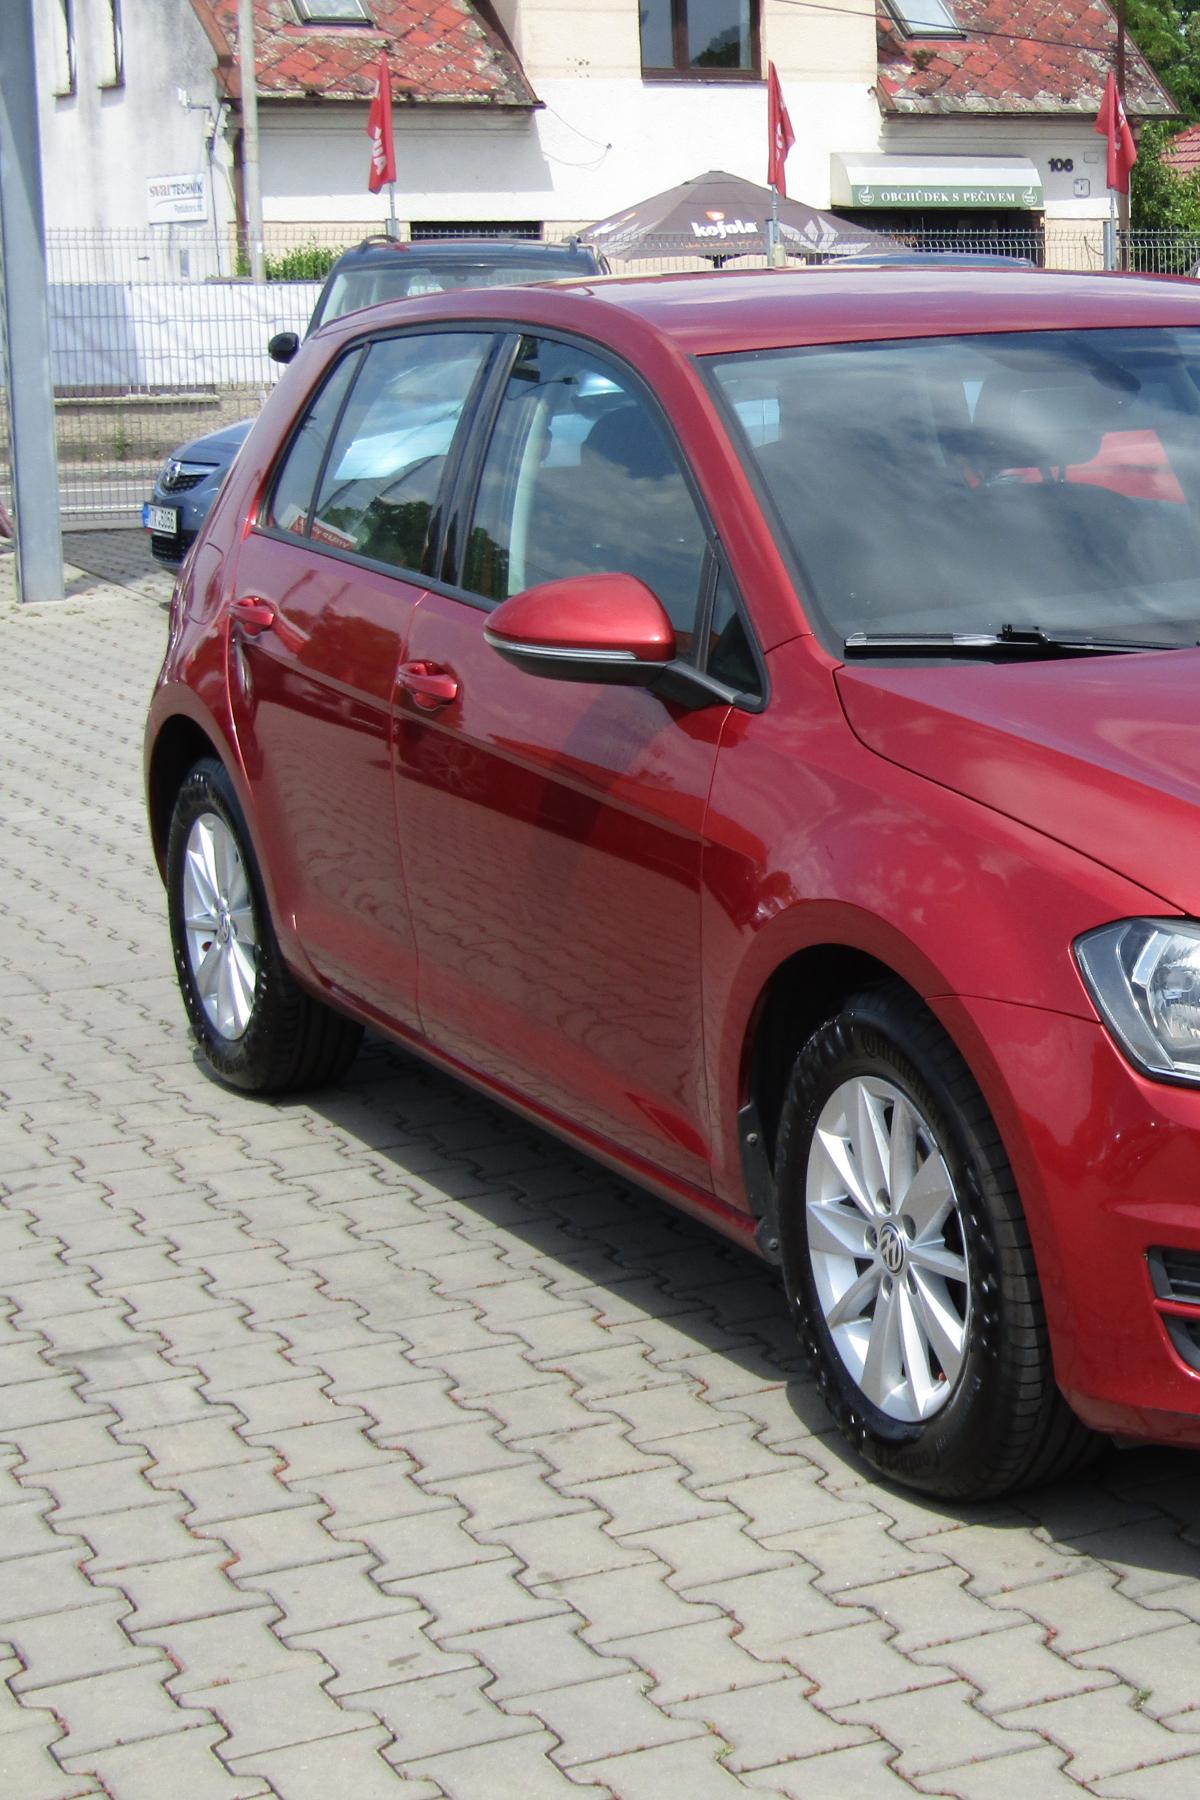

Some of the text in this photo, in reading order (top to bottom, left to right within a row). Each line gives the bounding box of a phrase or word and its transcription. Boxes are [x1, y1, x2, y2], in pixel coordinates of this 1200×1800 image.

[881, 189, 950, 203] OBCHŮDEK
[952, 191, 960, 203] S
[963, 189, 1016, 203] PEČIVEM
[691, 219, 758, 239] kofola
